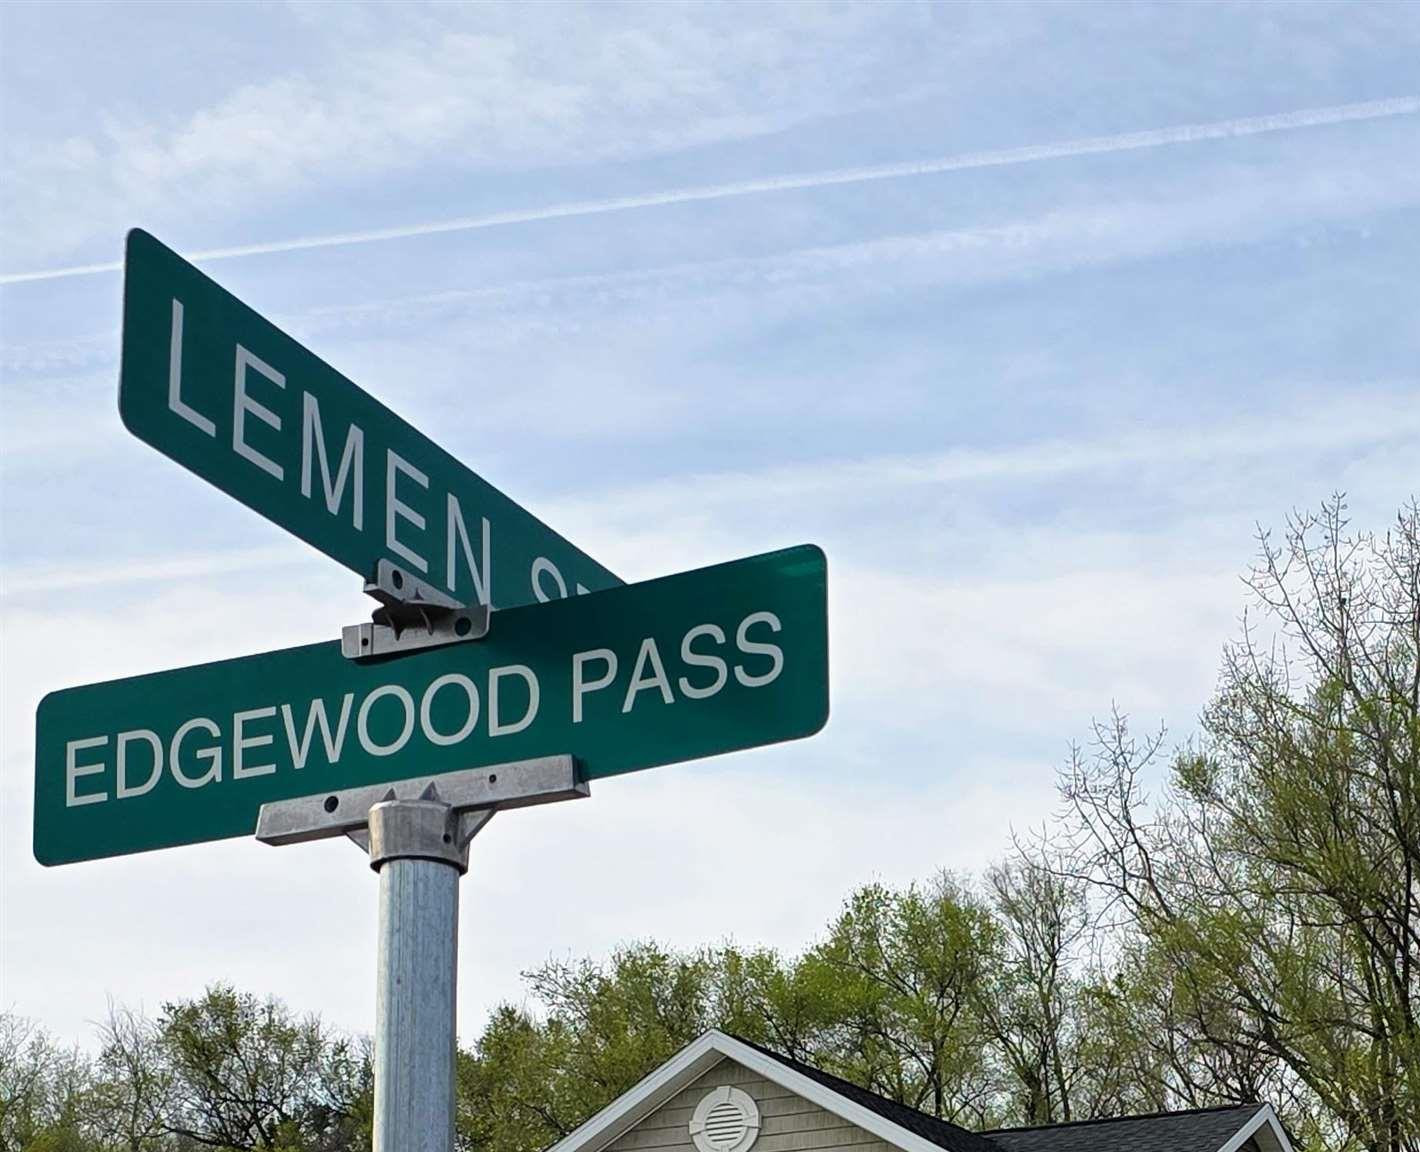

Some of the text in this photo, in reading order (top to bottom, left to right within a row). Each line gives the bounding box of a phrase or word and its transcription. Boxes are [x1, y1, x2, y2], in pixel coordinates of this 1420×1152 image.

[168, 297, 492, 608] LEMEN
[65, 610, 785, 808] EDGEWOOD PASS
